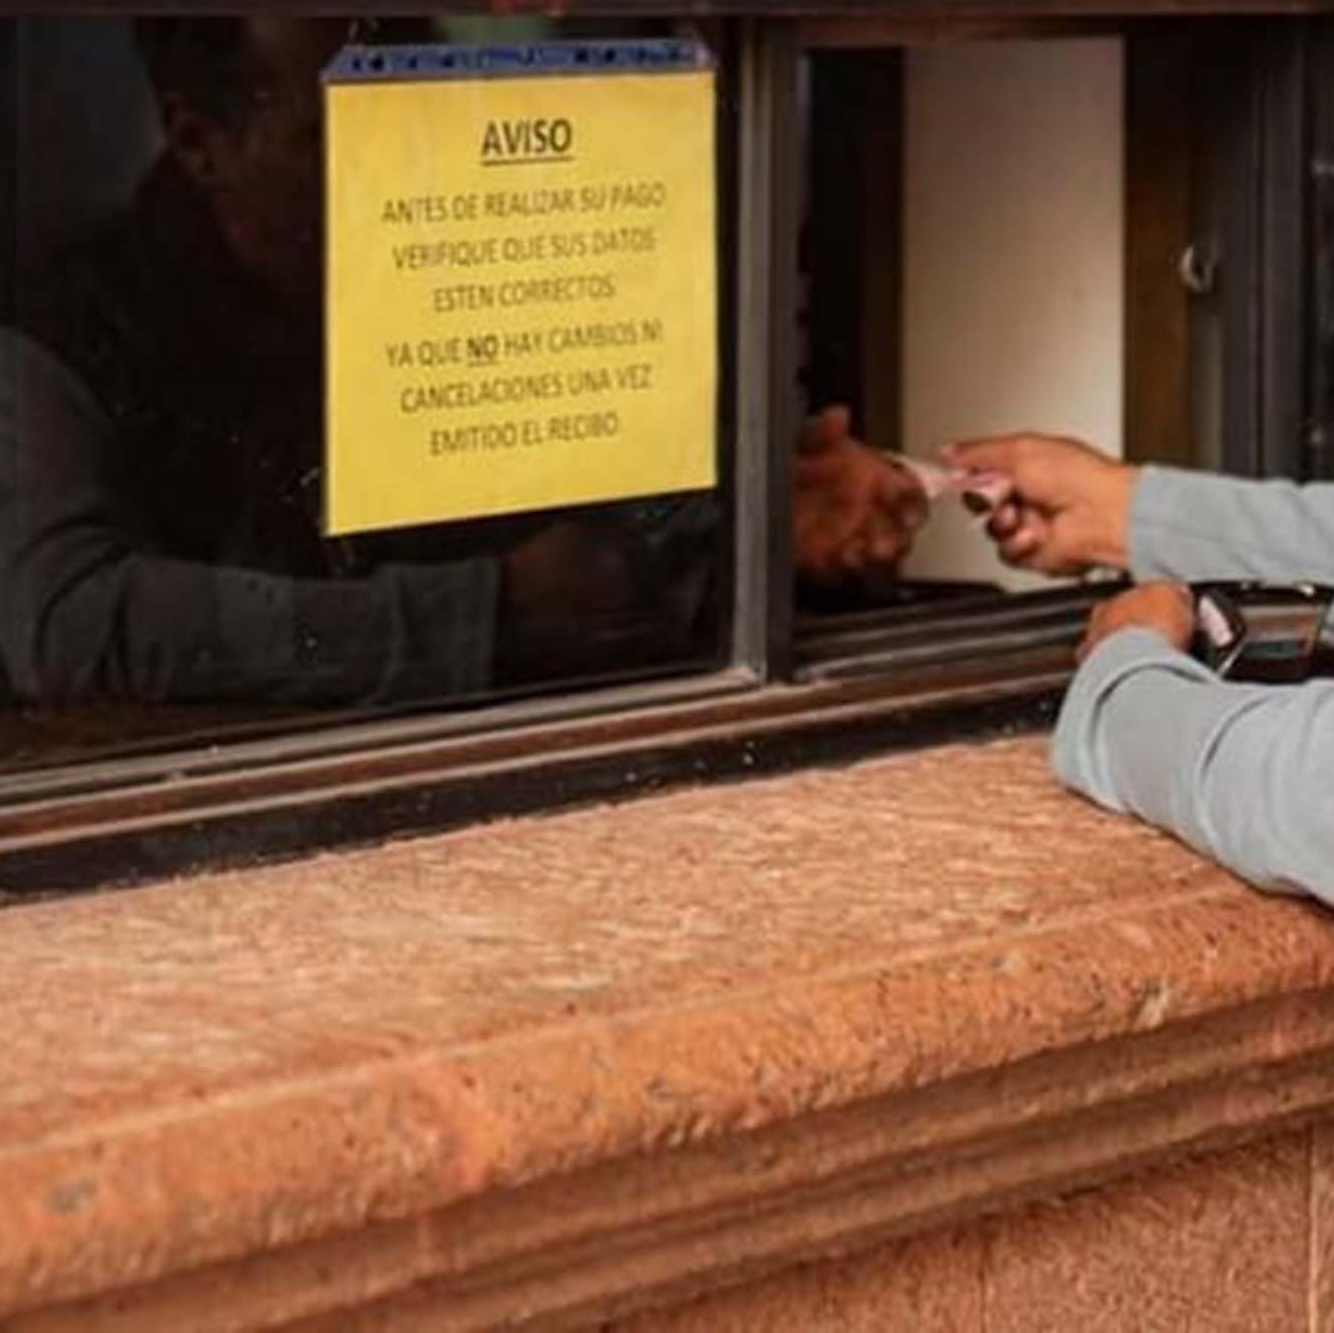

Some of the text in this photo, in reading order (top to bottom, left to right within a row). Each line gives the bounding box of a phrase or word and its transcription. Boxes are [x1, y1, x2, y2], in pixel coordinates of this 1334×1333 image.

[480, 118, 573, 157] AVISO
[382, 182, 666, 224] ANTES DE REALIZAR SU PAGO
[391, 226, 657, 272] VERIFIQUE QUE SUS DATOS
[434, 283, 494, 314] ESTEN
[385, 319, 663, 368] YA QUE NO HAY CAMBIOS NI
[400, 364, 653, 414] CANCELACIONES UNA VEZ
[430, 421, 518, 456] EMITIDO
[522, 419, 543, 446] EL
